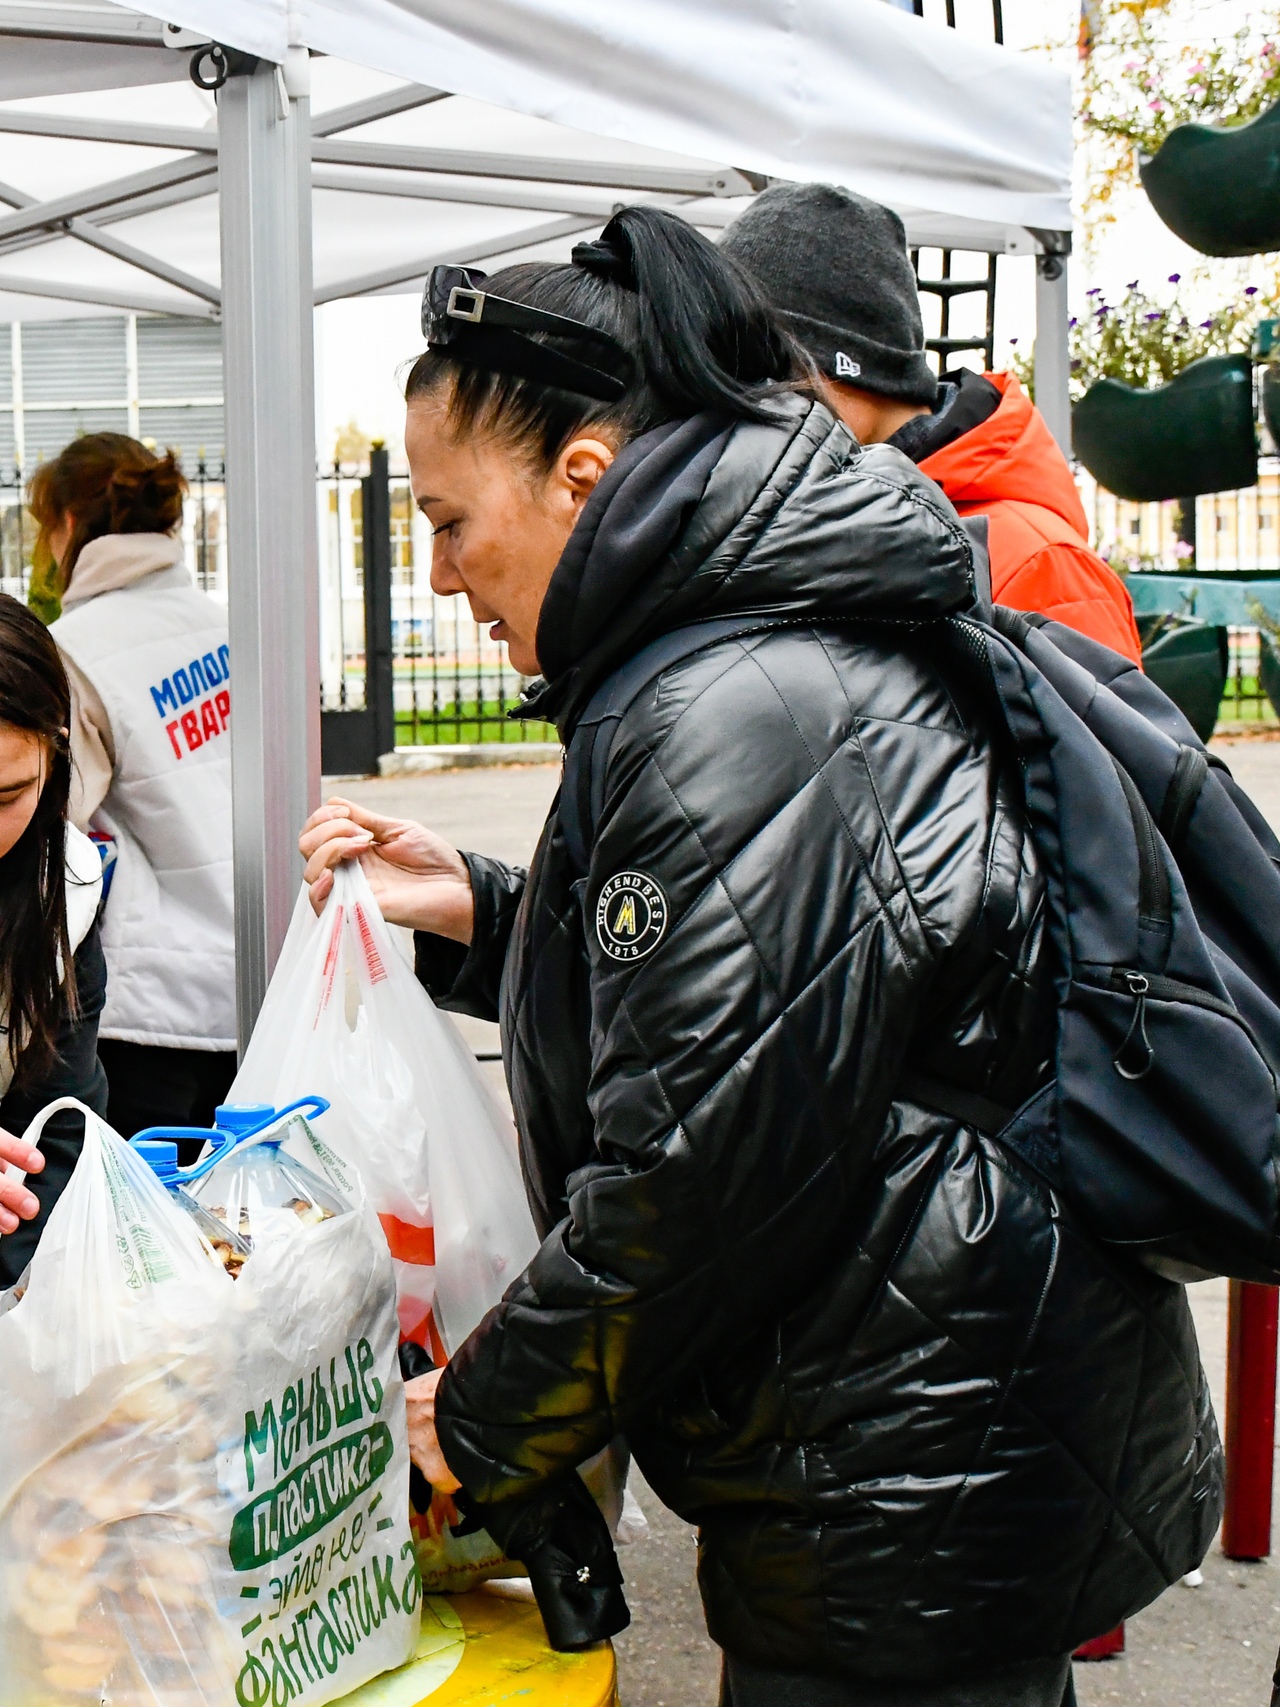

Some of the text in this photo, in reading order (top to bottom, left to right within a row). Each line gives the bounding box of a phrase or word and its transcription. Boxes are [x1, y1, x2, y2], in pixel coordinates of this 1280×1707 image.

[165, 689, 231, 761] ГВАР
[614, 876, 642, 889] END
[641, 883, 663, 934] BEST
[608, 942, 639, 957] 1978
[269, 1543, 325, 1620] это
[328, 1512, 366, 1572] не
